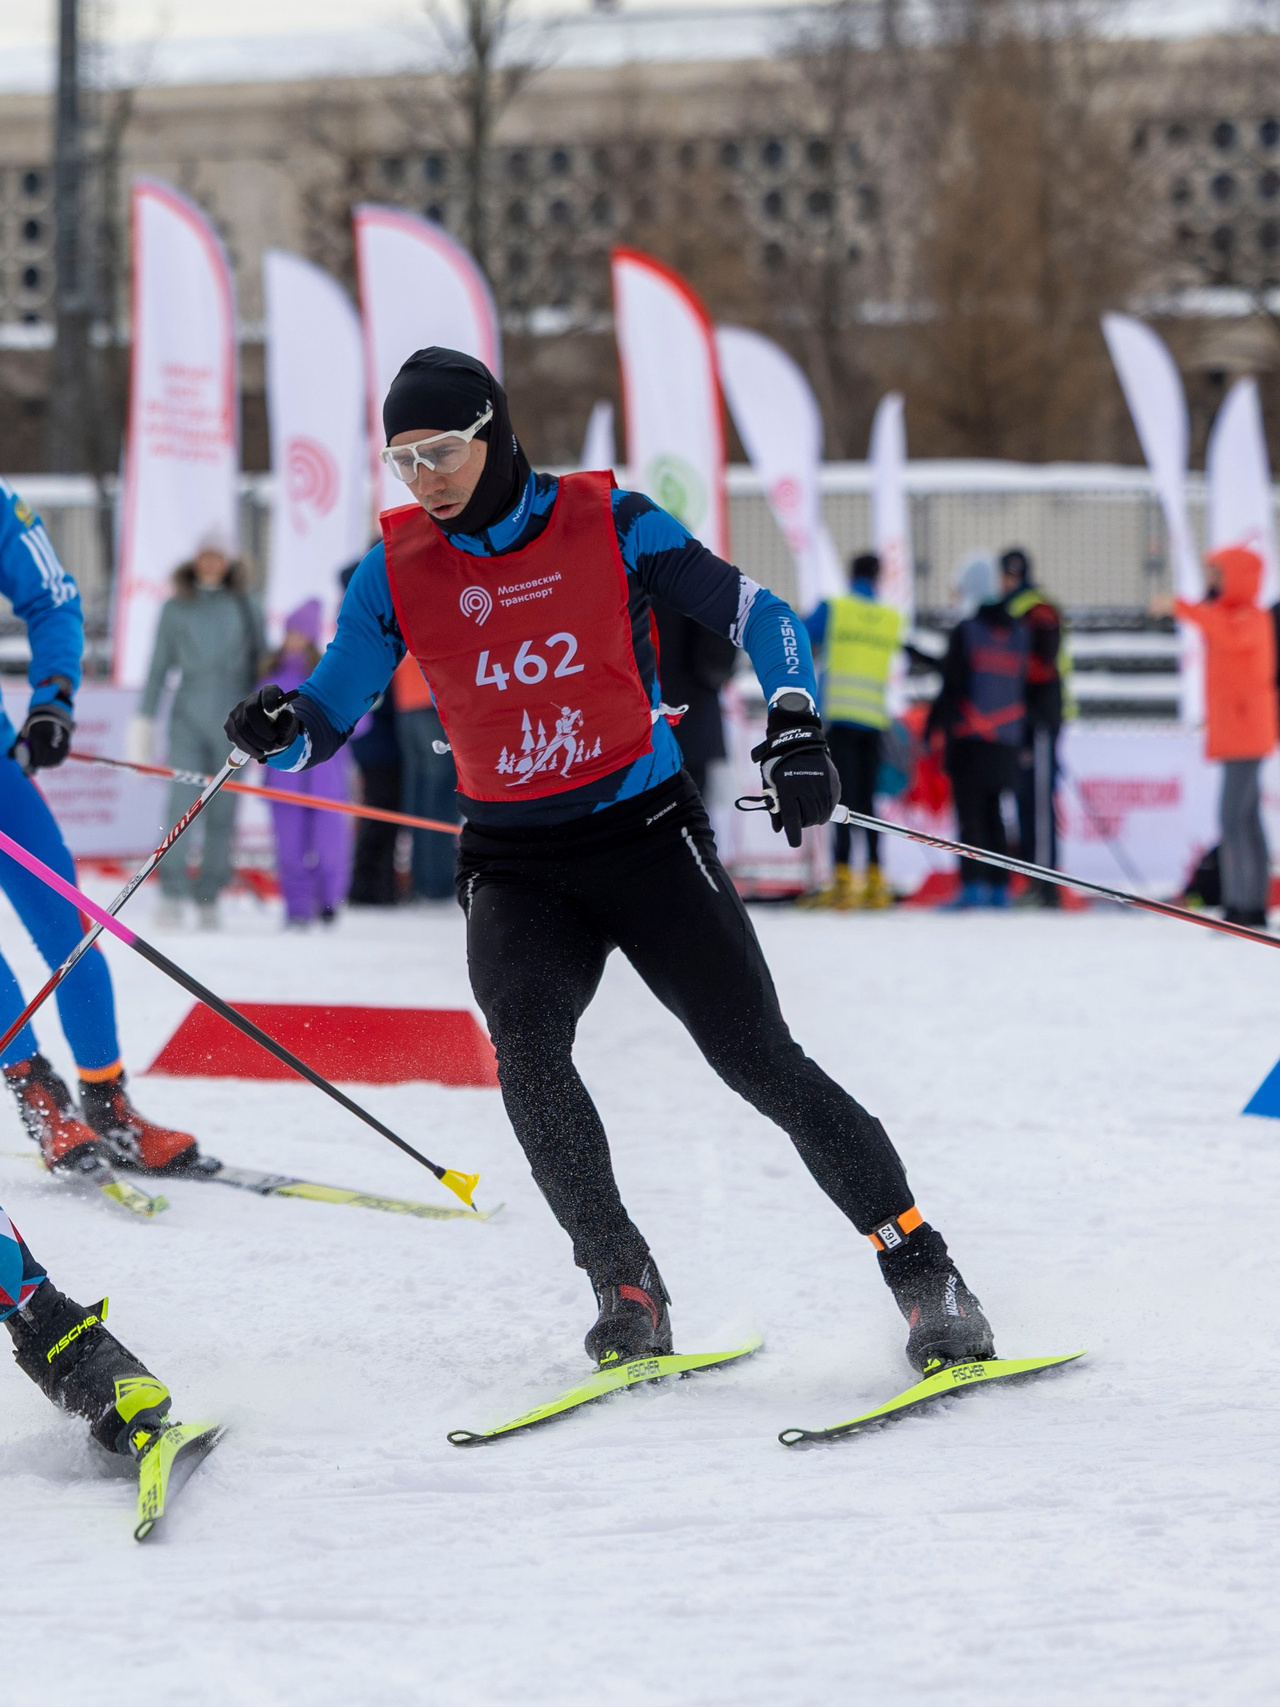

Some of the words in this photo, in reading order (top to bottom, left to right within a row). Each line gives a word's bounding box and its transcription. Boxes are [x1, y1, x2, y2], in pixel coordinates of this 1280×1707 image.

[497, 571, 562, 596] Московский
[500, 587, 553, 608] транспорт
[778, 616, 800, 675] NORDSKI
[475, 632, 585, 692] 462
[881, 1226, 898, 1246] 162
[46, 1314, 100, 1363] FISCHER
[627, 1360, 661, 1381] FISCHER
[952, 1364, 987, 1383] FISCHER
